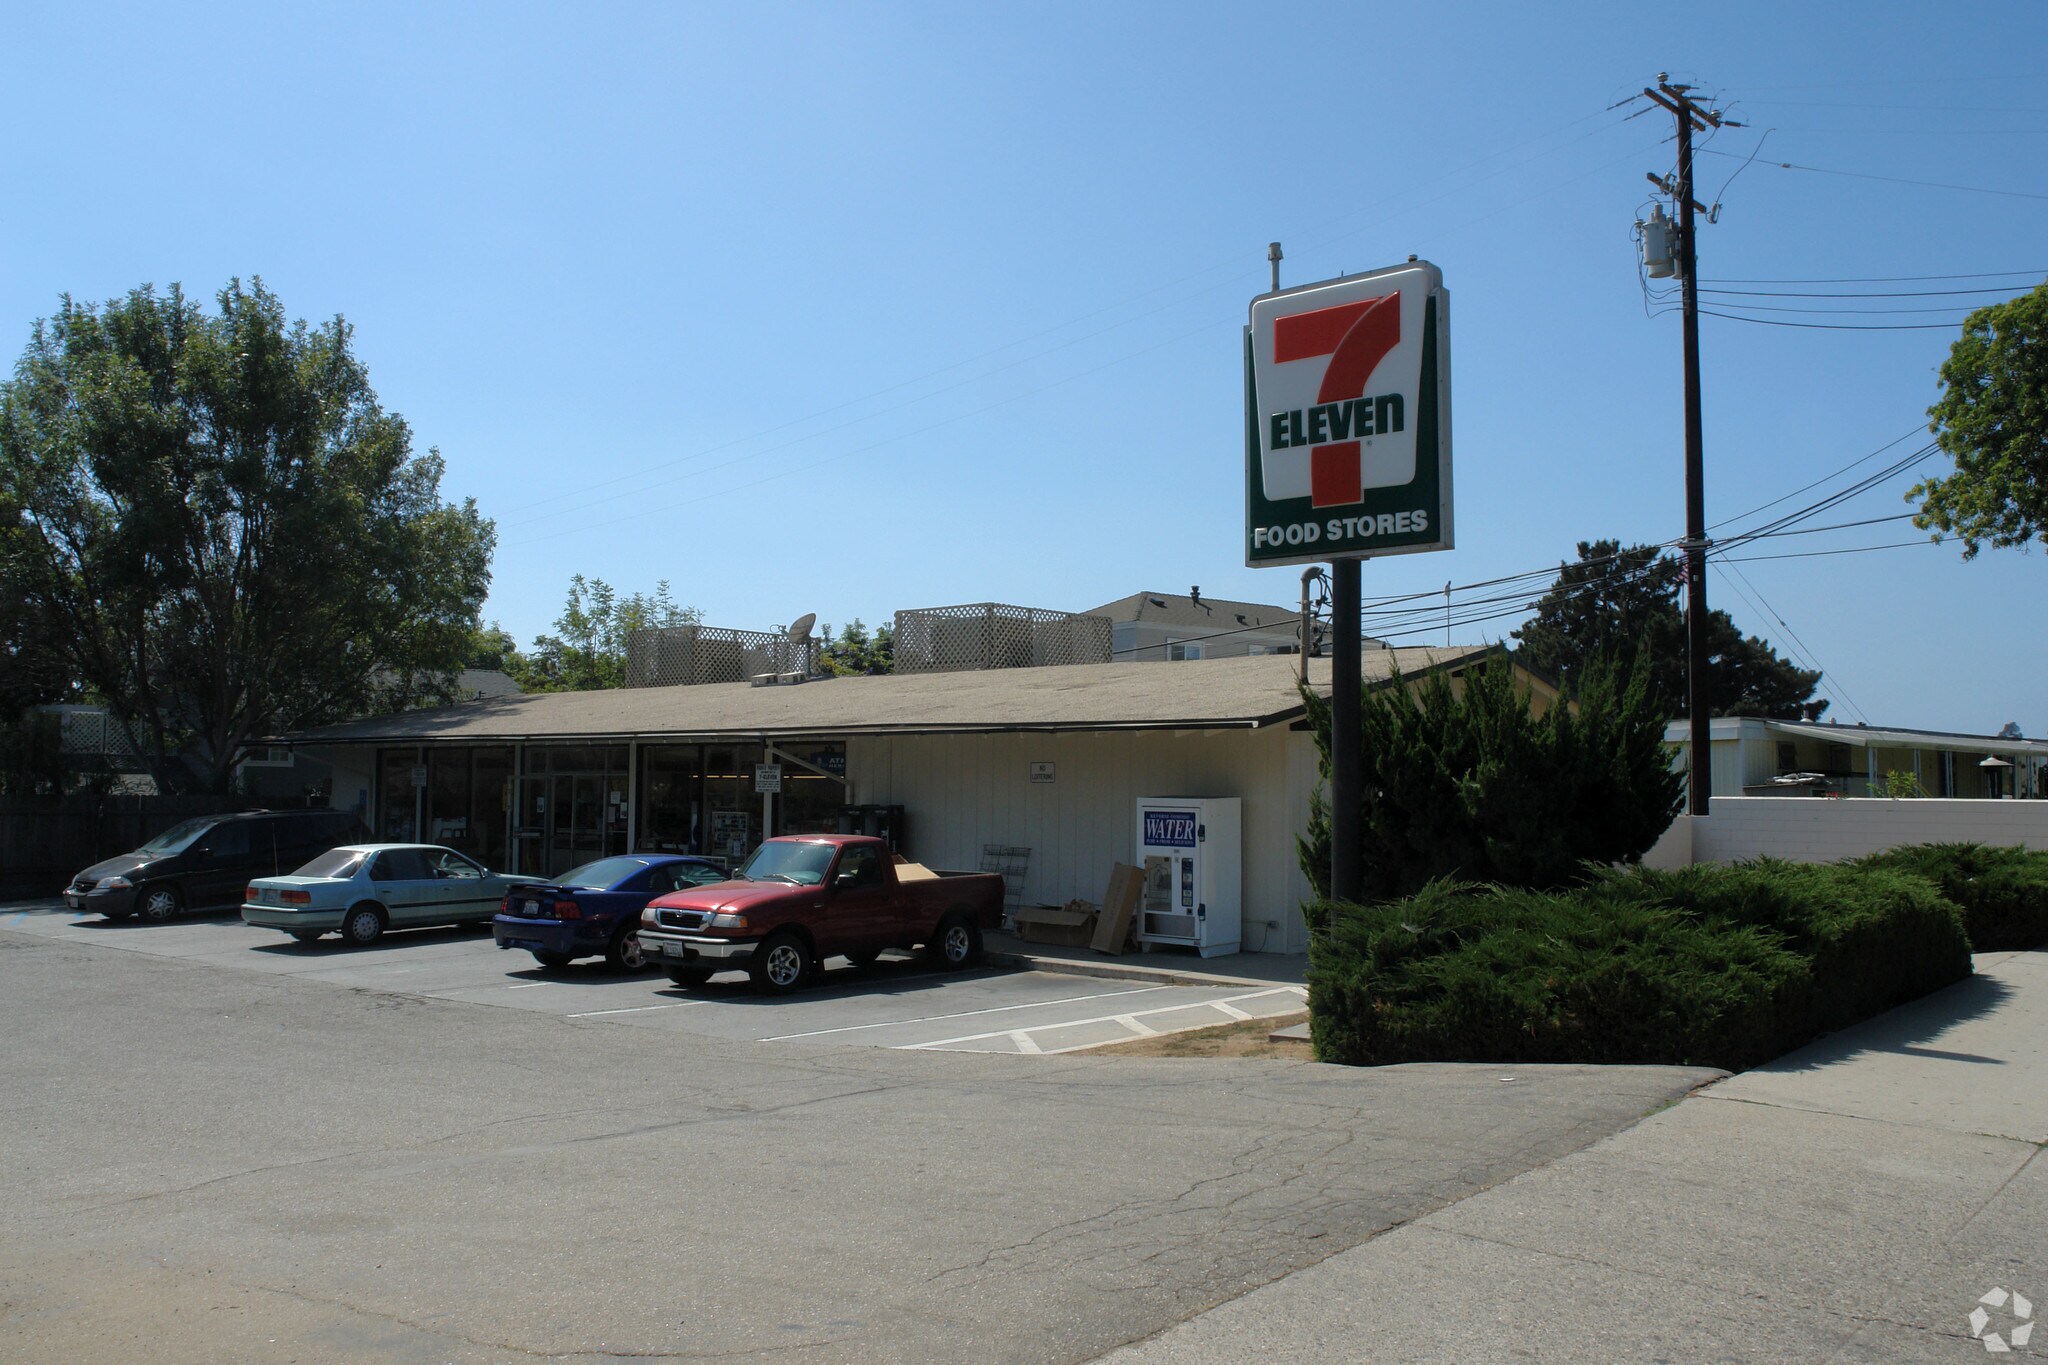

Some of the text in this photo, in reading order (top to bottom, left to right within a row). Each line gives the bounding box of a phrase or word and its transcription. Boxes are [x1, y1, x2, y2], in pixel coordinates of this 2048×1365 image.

[1274, 289, 1401, 509] 7
[1254, 509, 1429, 550] FOOD STORES
[1146, 818, 1194, 840] WATER
